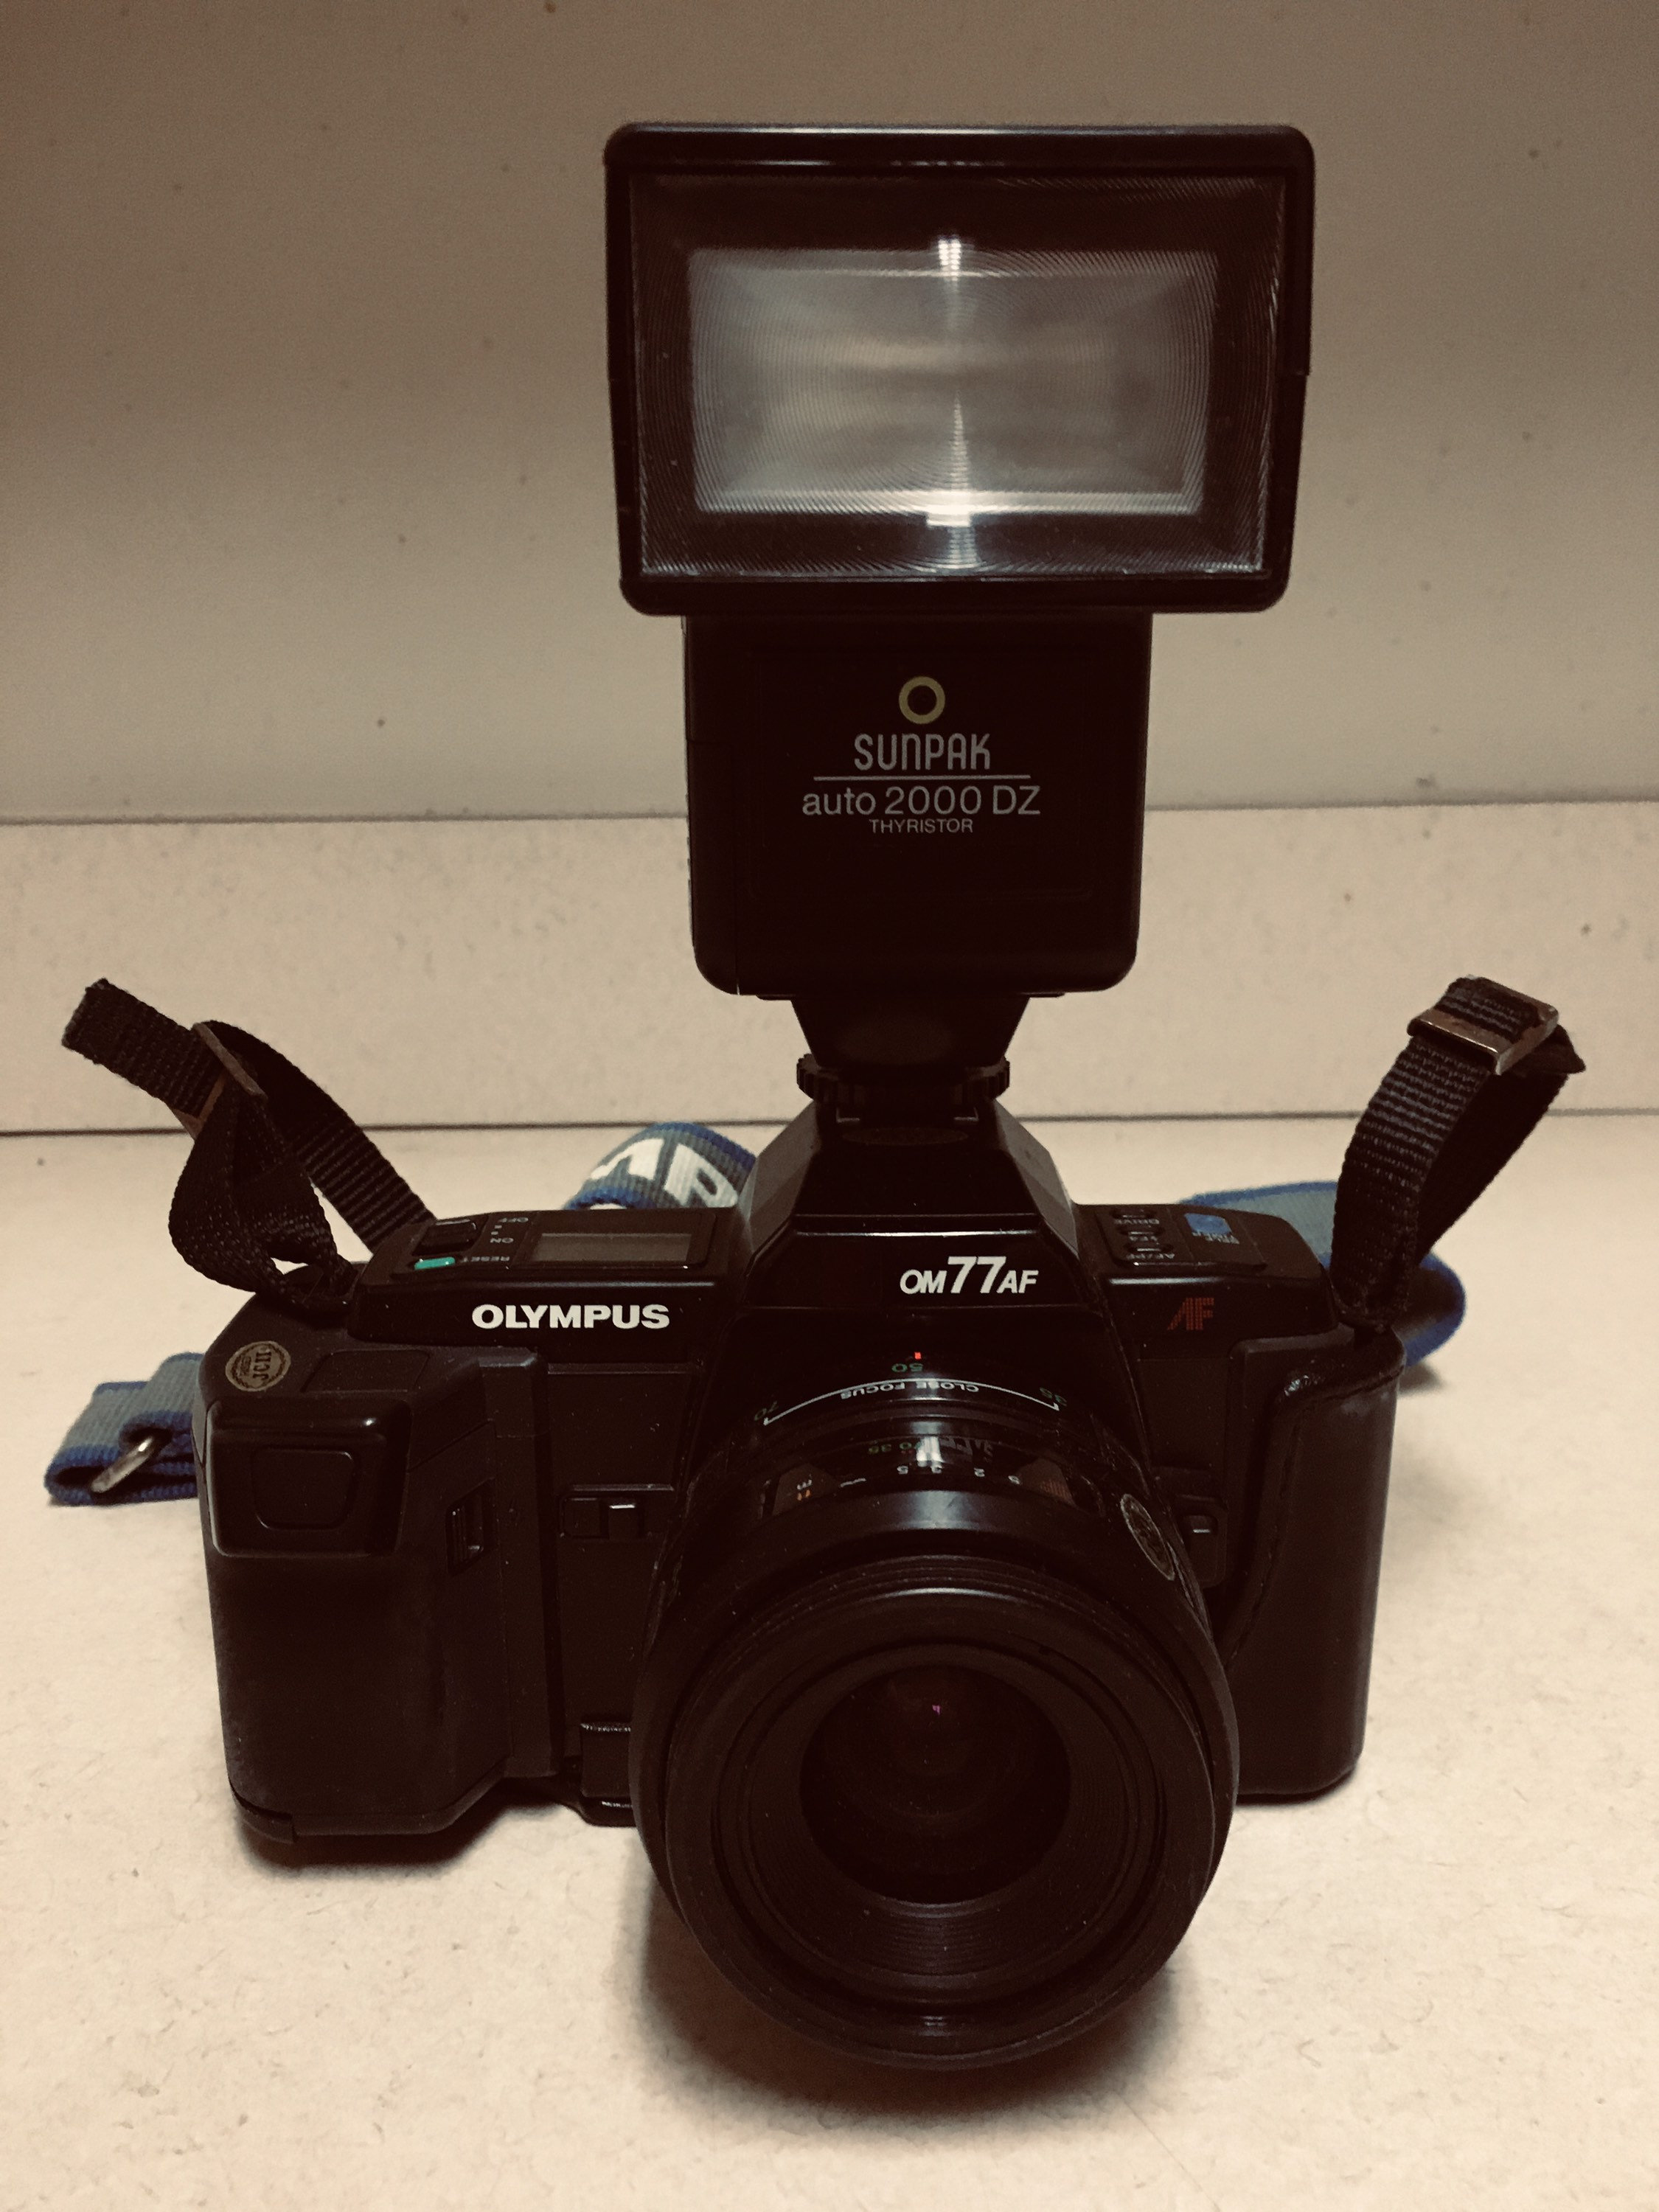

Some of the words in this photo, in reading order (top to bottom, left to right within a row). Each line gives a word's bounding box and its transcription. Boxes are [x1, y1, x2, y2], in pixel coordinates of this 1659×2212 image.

[853, 733, 991, 771] SUNPAK
[801, 787, 877, 815] auto
[885, 785, 982, 815] 2000
[992, 785, 1041, 815] DZ
[869, 818, 974, 834] THYRISTOR
[471, 1304, 670, 1329] OLYMPUS
[1167, 1297, 1215, 1331] AF
[891, 1363, 924, 1372] 50
[840, 1381, 906, 1399] FOCUS
